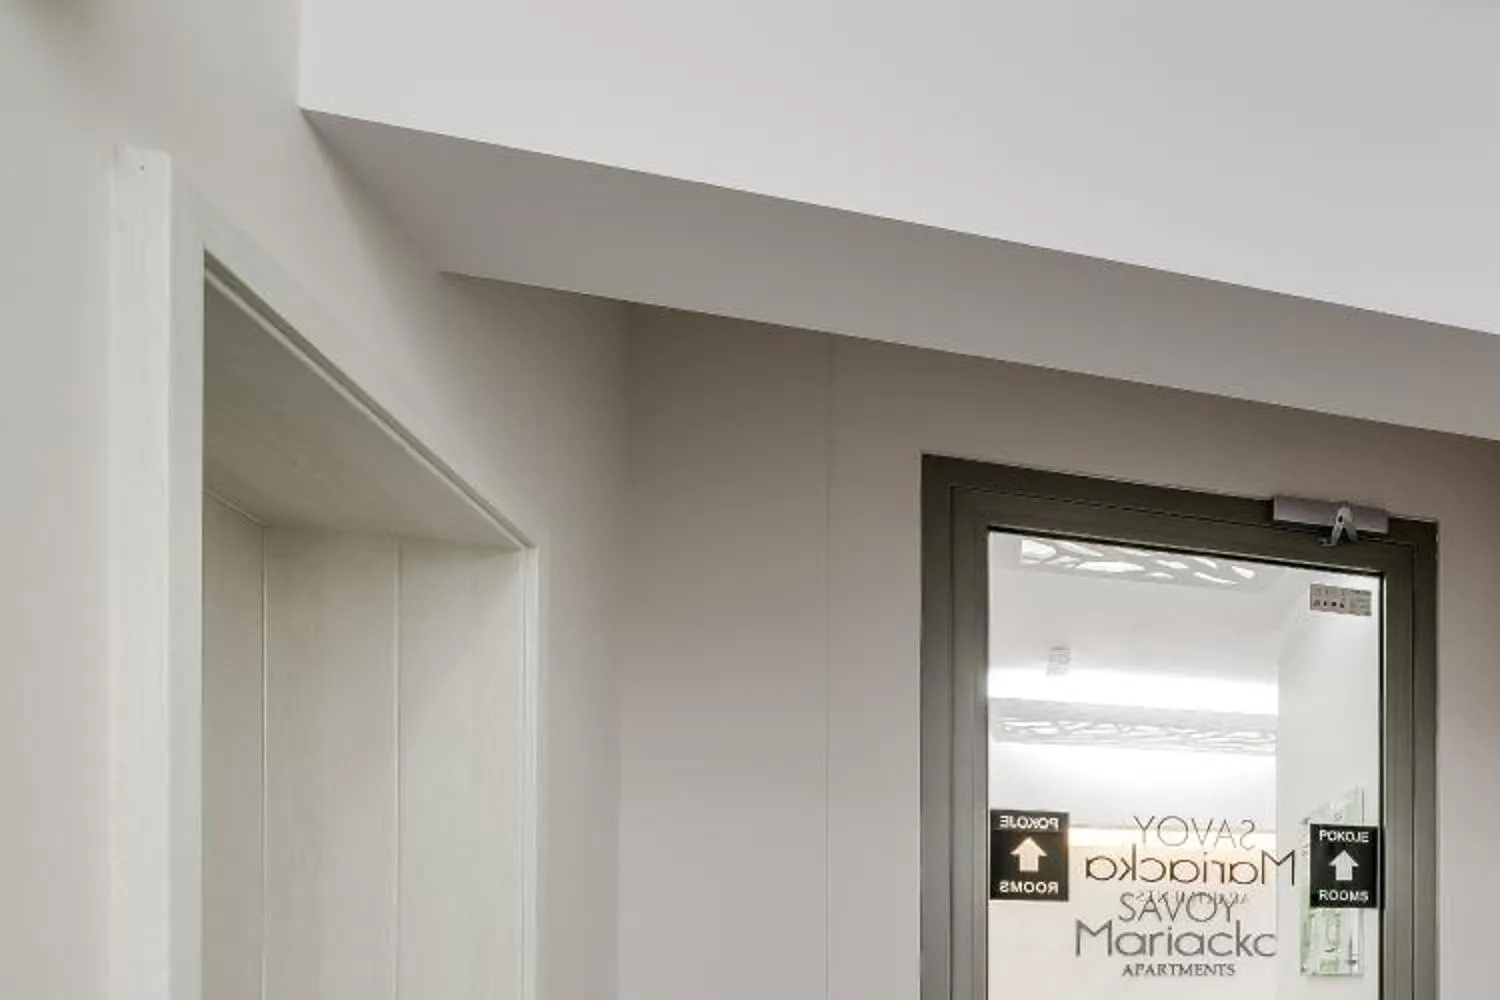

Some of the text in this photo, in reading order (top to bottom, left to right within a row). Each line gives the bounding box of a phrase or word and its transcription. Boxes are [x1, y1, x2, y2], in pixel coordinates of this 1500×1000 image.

[1319, 829, 1370, 843] POKOJE
[1319, 889, 1369, 903] ROOMS
[1118, 891, 1235, 923] SAVOY
[1122, 963, 1236, 978] APARTMENTS
